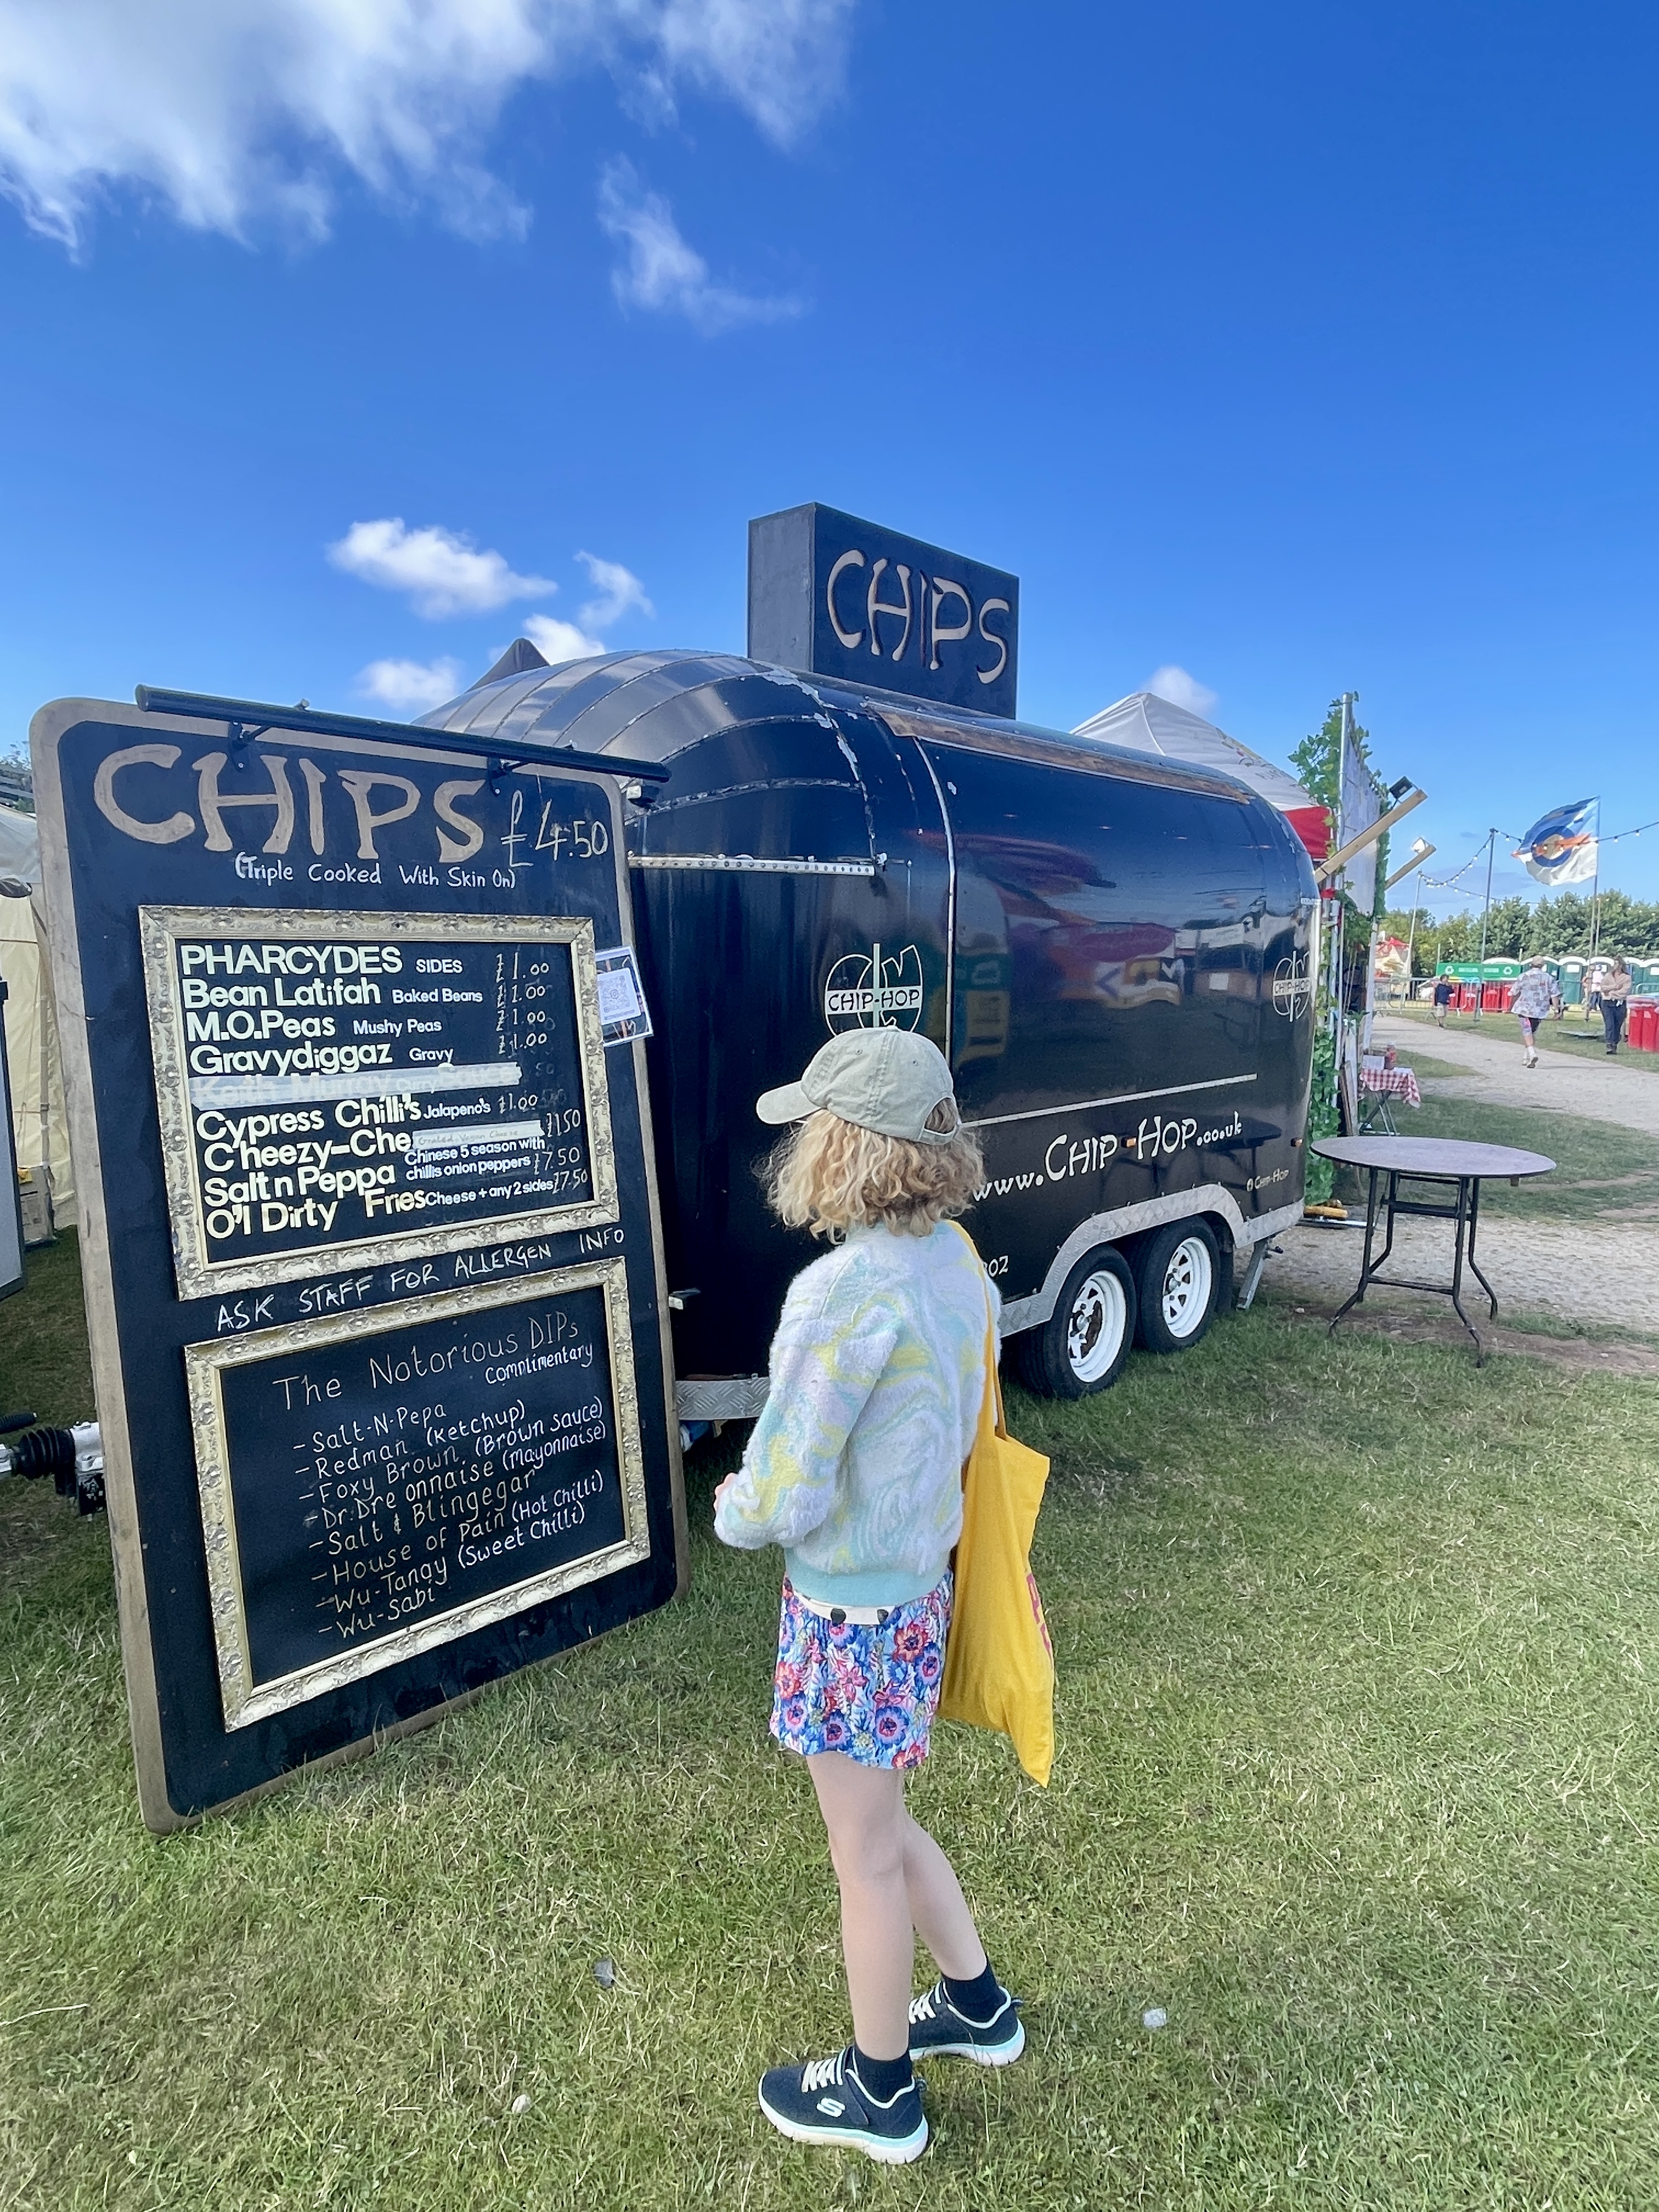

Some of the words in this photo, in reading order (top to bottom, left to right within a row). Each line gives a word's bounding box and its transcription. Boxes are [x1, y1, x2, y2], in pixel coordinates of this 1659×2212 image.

[827, 549, 1009, 684] CHIPS
[94, 744, 486, 862] CHIPS
[308, 862, 381, 884] Cooked
[399, 865, 439, 885] With
[447, 867, 486, 888] Skin
[180, 945, 403, 975] PHARCYDES
[416, 959, 462, 973] SIDES
[182, 979, 268, 1008] Bean
[275, 977, 381, 1006] Latifah
[392, 989, 438, 1004] Baked
[442, 989, 483, 1002] Beans
[828, 990, 919, 1011] CHIP-HOP
[185, 1010, 336, 1041] M.O.Peas
[353, 1019, 402, 1037] Mushy
[407, 1019, 442, 1034] Peas
[190, 1041, 392, 1076] Gravydiggaz
[409, 1048, 453, 1063] Gravy
[196, 1109, 325, 1148] Cypress
[335, 1093, 421, 1127] Chilli's
[424, 1097, 491, 1119] Jalapeno's
[204, 1171, 270, 1207] Salt
[297, 1164, 396, 1199] Peppa
[404, 1147, 457, 1166] Chinese
[460, 1144, 469, 1158] 5
[471, 1141, 517, 1155] season
[518, 1136, 545, 1150] with
[444, 1163, 477, 1176] onion
[478, 1155, 531, 1175] peppers
[261, 1198, 338, 1232] Dirty
[365, 1188, 425, 1217] Fries
[425, 1192, 476, 1206] Cheese
[489, 1184, 512, 1199] any
[514, 1182, 522, 1195] 2
[523, 1179, 554, 1193] sides
[217, 1294, 274, 1331] ASK
[298, 1274, 374, 1313] STAFF
[390, 1263, 439, 1292] FOR
[455, 1244, 551, 1278] ALLERGEN
[579, 1228, 624, 1254] INFO
[272, 1375, 342, 1410] The
[370, 1333, 518, 1389] Notorious
[387, 1446, 459, 1484] Brown
[412, 1469, 535, 1528] Blingegar
[426, 1527, 447, 1550] of
[459, 1511, 504, 1542] Pain
